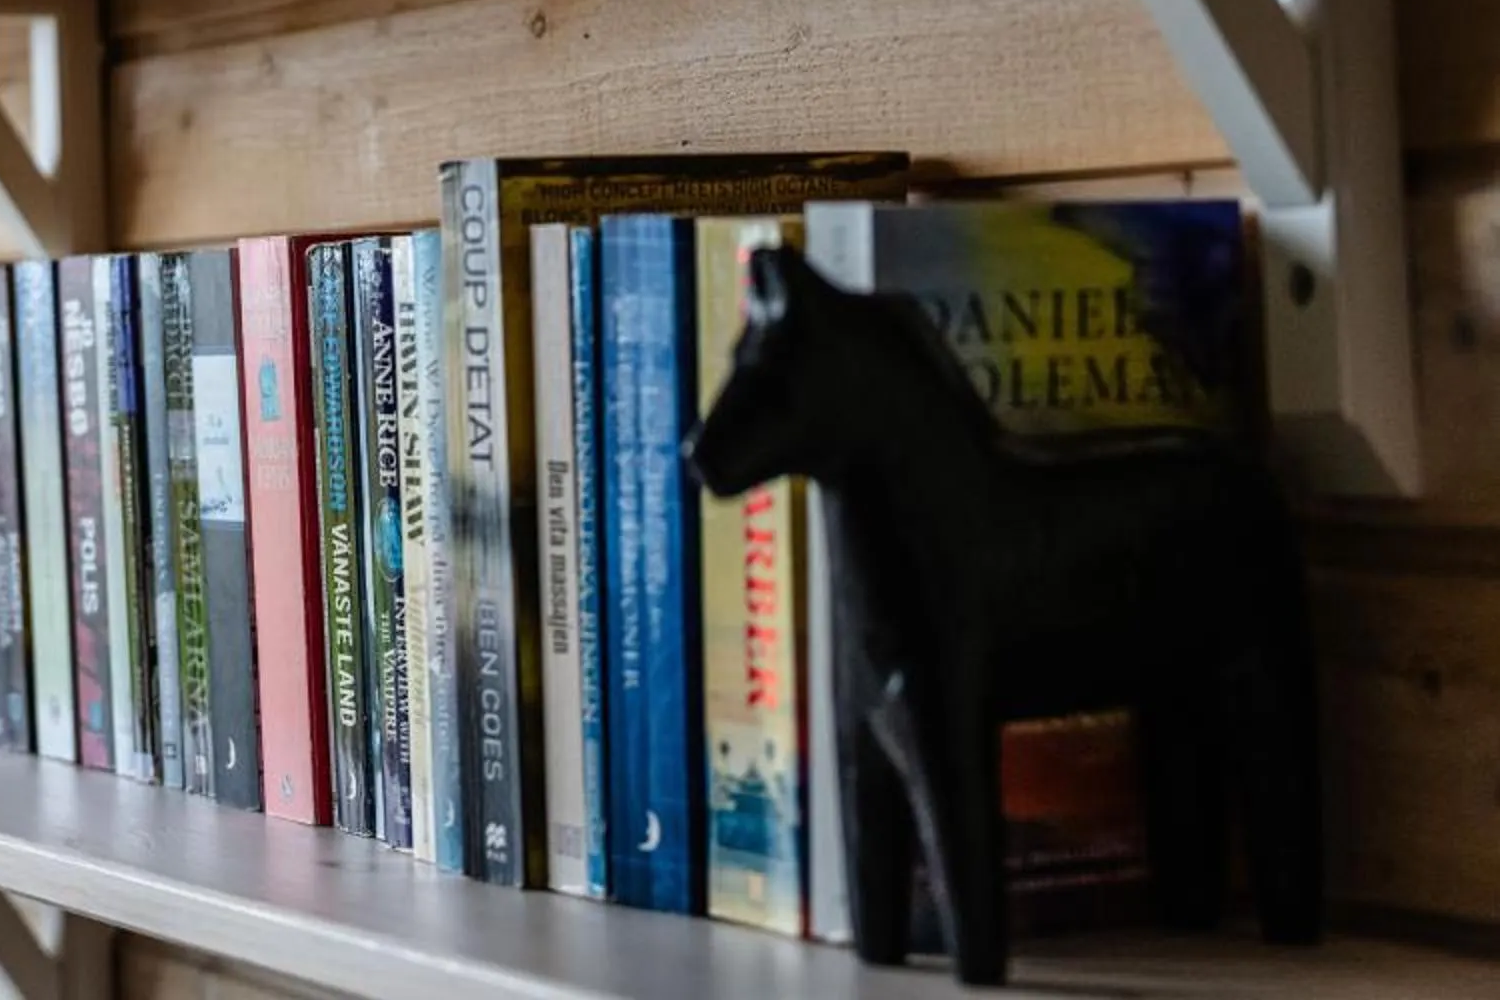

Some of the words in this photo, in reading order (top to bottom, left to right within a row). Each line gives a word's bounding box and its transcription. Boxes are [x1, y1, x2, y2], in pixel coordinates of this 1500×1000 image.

[461, 185, 488, 310] COUP
[79, 314, 94, 347] JO
[371, 320, 395, 405] ANNE
[399, 302, 420, 417] IRWIN
[322, 337, 347, 512] EDWARDSON
[375, 411, 399, 488] RICE
[403, 431, 426, 546] SHAW
[547, 459, 569, 499] Den
[550, 506, 569, 547] vita
[79, 516, 99, 616] POLIS
[331, 524, 353, 646] VÄNASTE
[548, 553, 571, 656] massajen
[179, 500, 208, 733] SAMLARNA
[393, 597, 411, 715] INTERVIEW
[479, 600, 500, 677] BEN
[337, 653, 357, 727] LAND
[382, 648, 399, 745] VAMPIRE
[581, 612, 599, 723] RINGEN
[481, 689, 503, 781] COES
